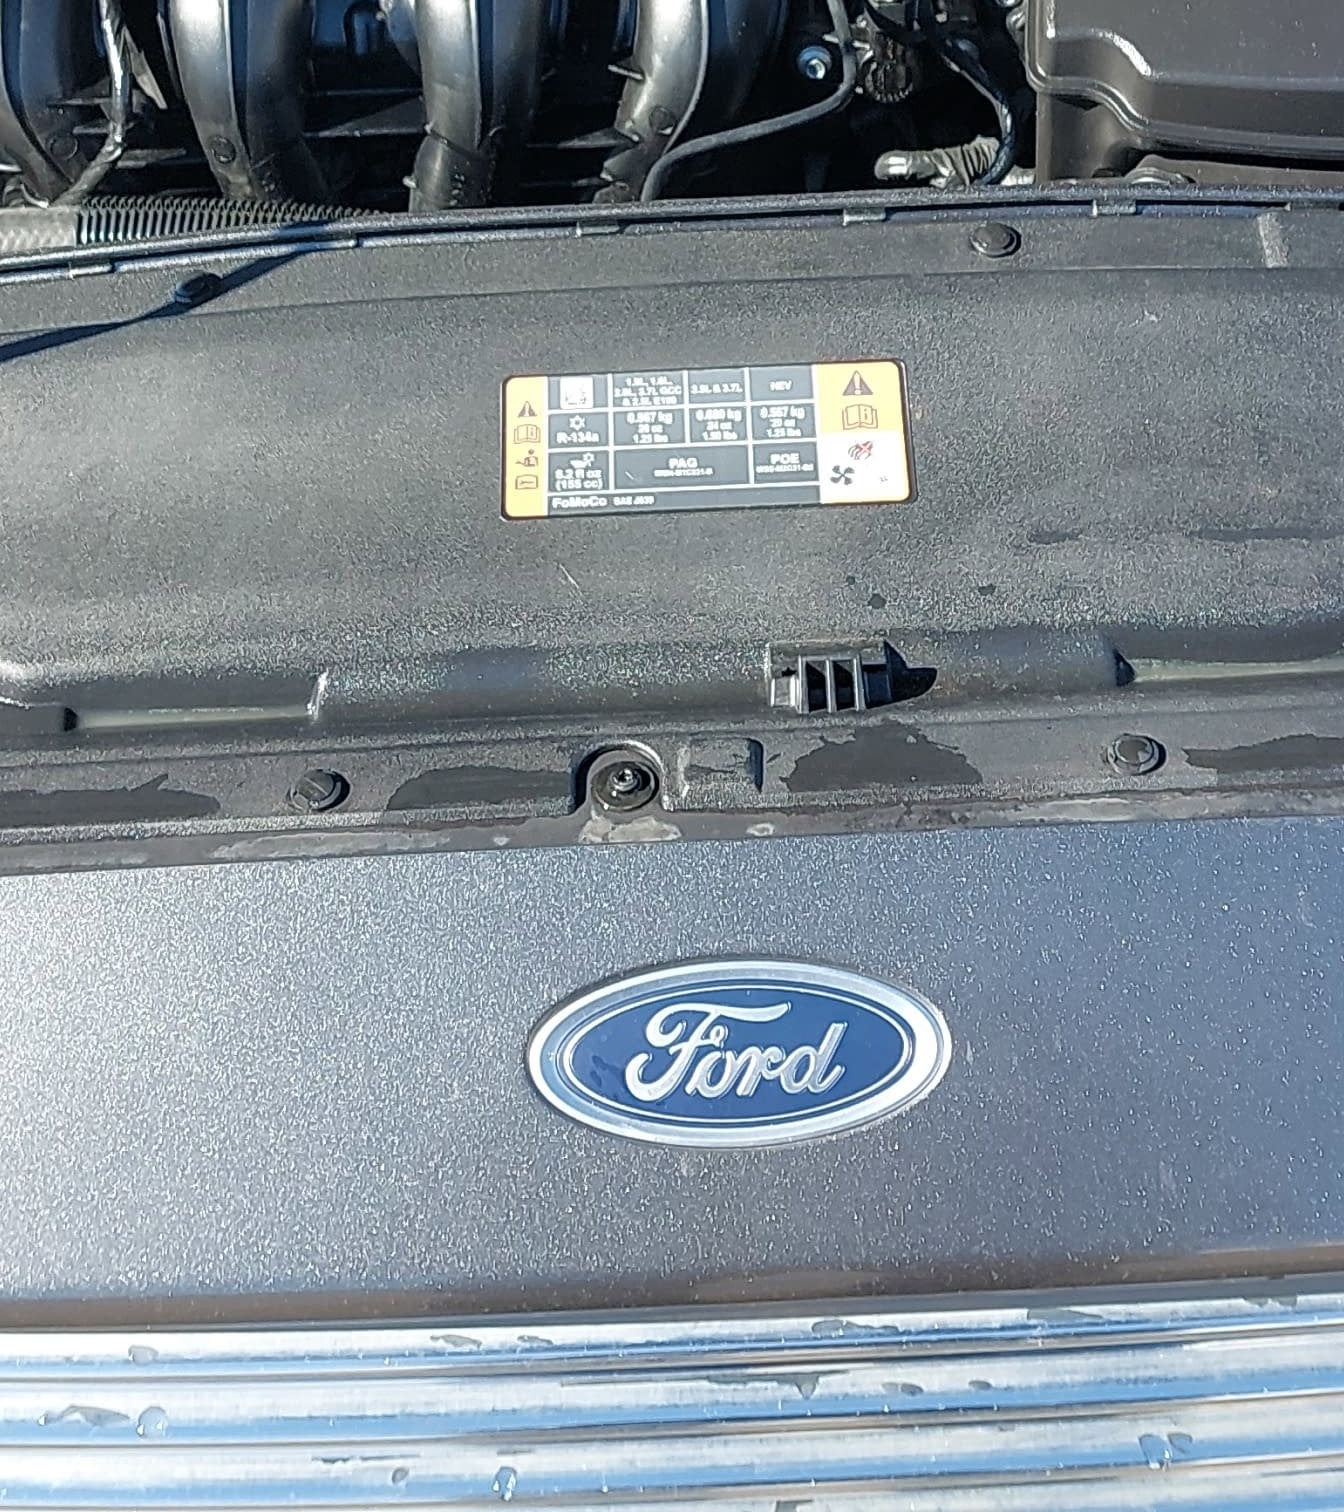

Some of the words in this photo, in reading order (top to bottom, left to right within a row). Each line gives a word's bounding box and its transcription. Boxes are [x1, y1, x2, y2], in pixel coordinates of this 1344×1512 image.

[556, 431, 600, 444] R-134a
[669, 457, 698, 469] PAG
[769, 452, 800, 465] POE
[551, 495, 608, 508] FoMoCo
[625, 1001, 848, 1102] Ford
